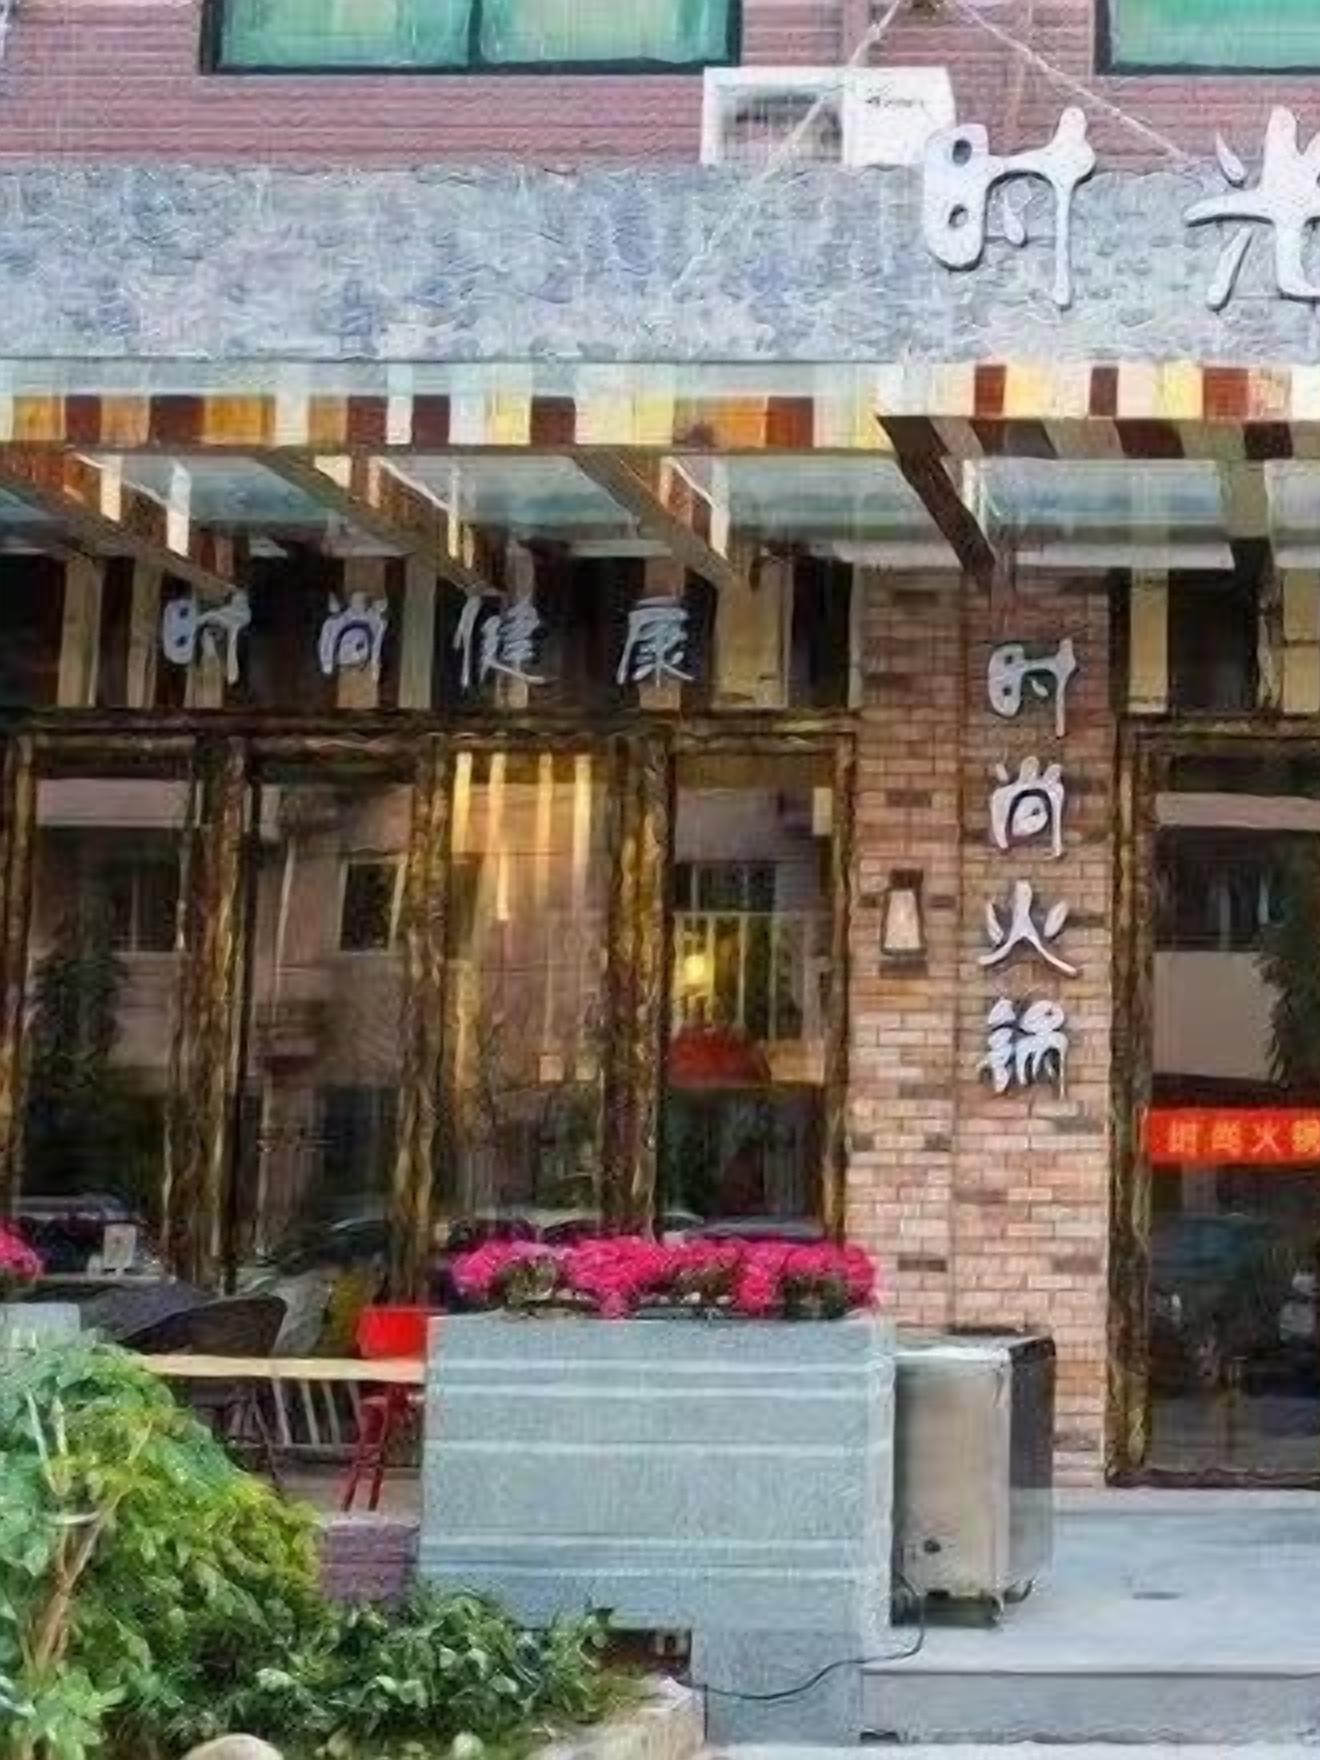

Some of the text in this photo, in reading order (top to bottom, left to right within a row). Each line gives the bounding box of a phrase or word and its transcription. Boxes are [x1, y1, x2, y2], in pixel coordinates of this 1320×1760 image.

[162, 592, 697, 688] 时尚健康
[978, 637, 1080, 1100] 时尚火锅
